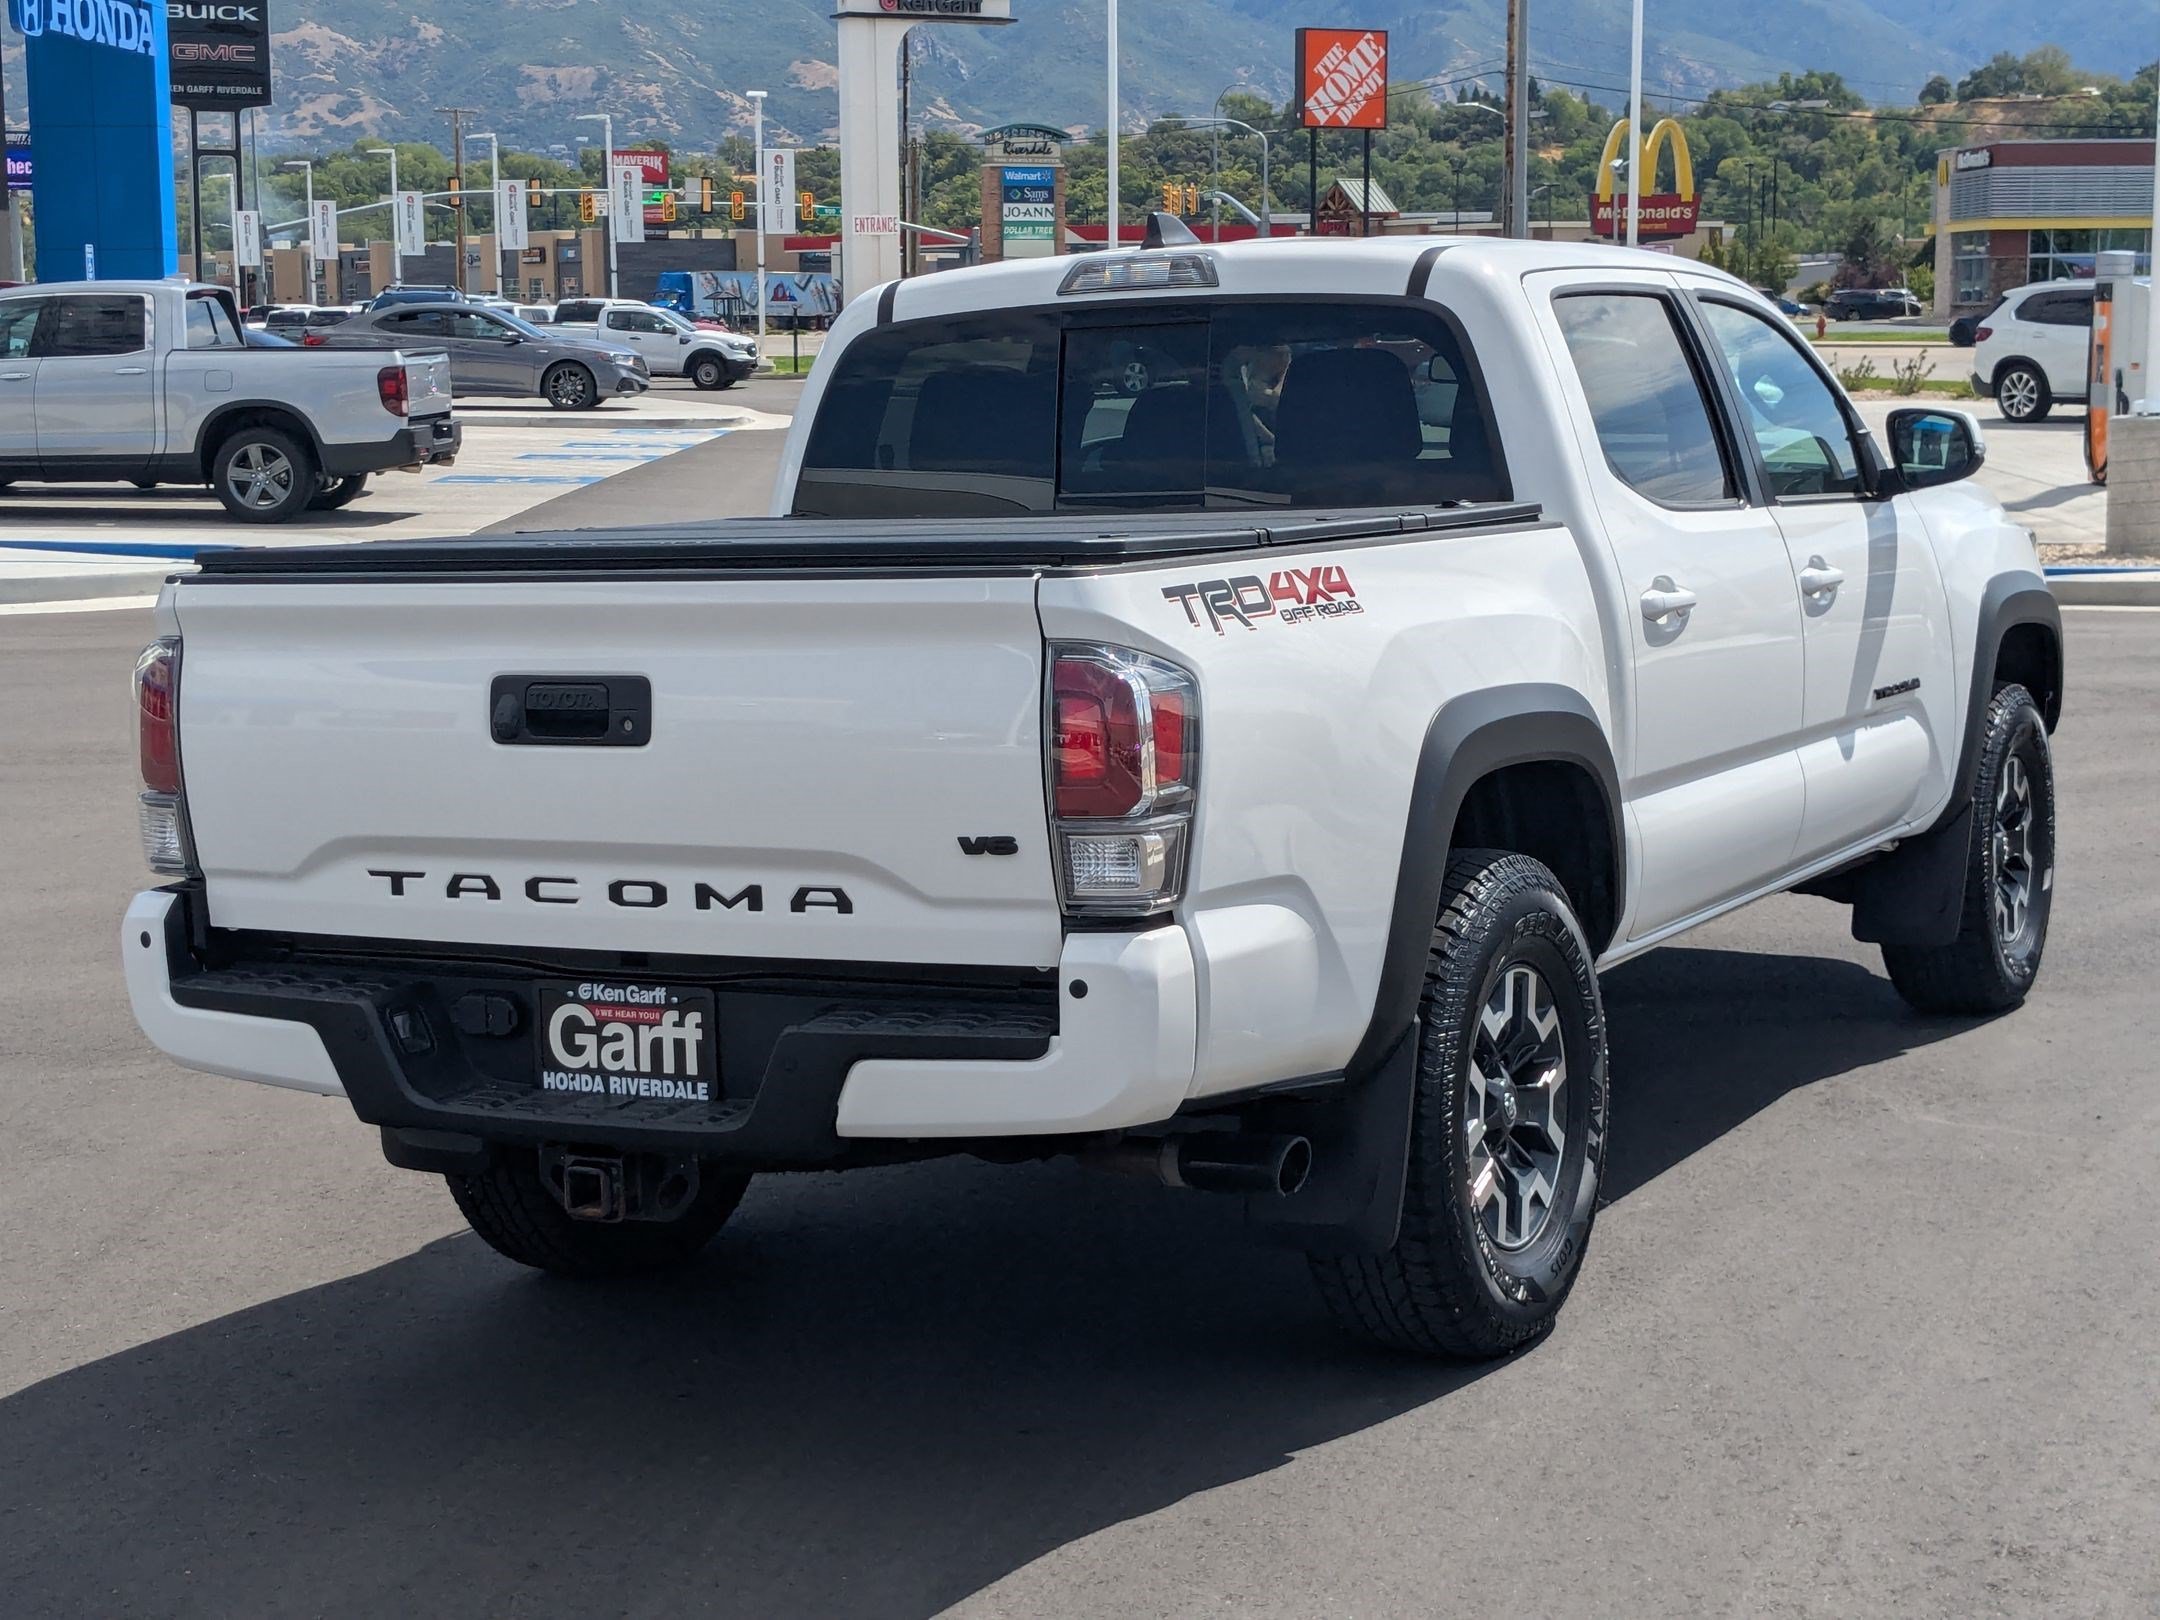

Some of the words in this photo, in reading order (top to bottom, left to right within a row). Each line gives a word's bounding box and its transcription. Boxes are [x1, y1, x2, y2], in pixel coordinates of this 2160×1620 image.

[166, 4, 260, 21] BUICK
[50, 0, 156, 56] HONDA
[172, 43, 256, 62] GMC
[1313, 42, 1347, 79] THE
[1305, 32, 1386, 125] HOME
[187, 85, 215, 94] GARFF
[217, 86, 263, 95] RIVERDALE
[1336, 68, 1385, 126] DEPOT
[1003, 140, 1053, 155] Riverdale
[7, 158, 33, 175] hec
[613, 155, 663, 174] MAVERIK
[1005, 171, 1041, 181] Walmart
[854, 216, 898, 233] ENTRANCE
[1004, 226, 1032, 235] DOLLAR
[1035, 226, 1054, 235] TREE
[1161, 575, 1277, 636] TRD
[1280, 607, 1316, 625] OFF
[1316, 600, 1364, 619] ROAD
[530, 693, 600, 709] TOYOTA
[957, 836, 1019, 856] V6
[367, 869, 854, 915] TACOMA
[600, 1010, 614, 1018] WE
[615, 1010, 637, 1020] HEAR
[639, 1011, 656, 1021] YOU
[548, 1003, 703, 1076] Garff
[543, 1071, 606, 1094] HONDA
[609, 1076, 709, 1100] RIVERDALE
